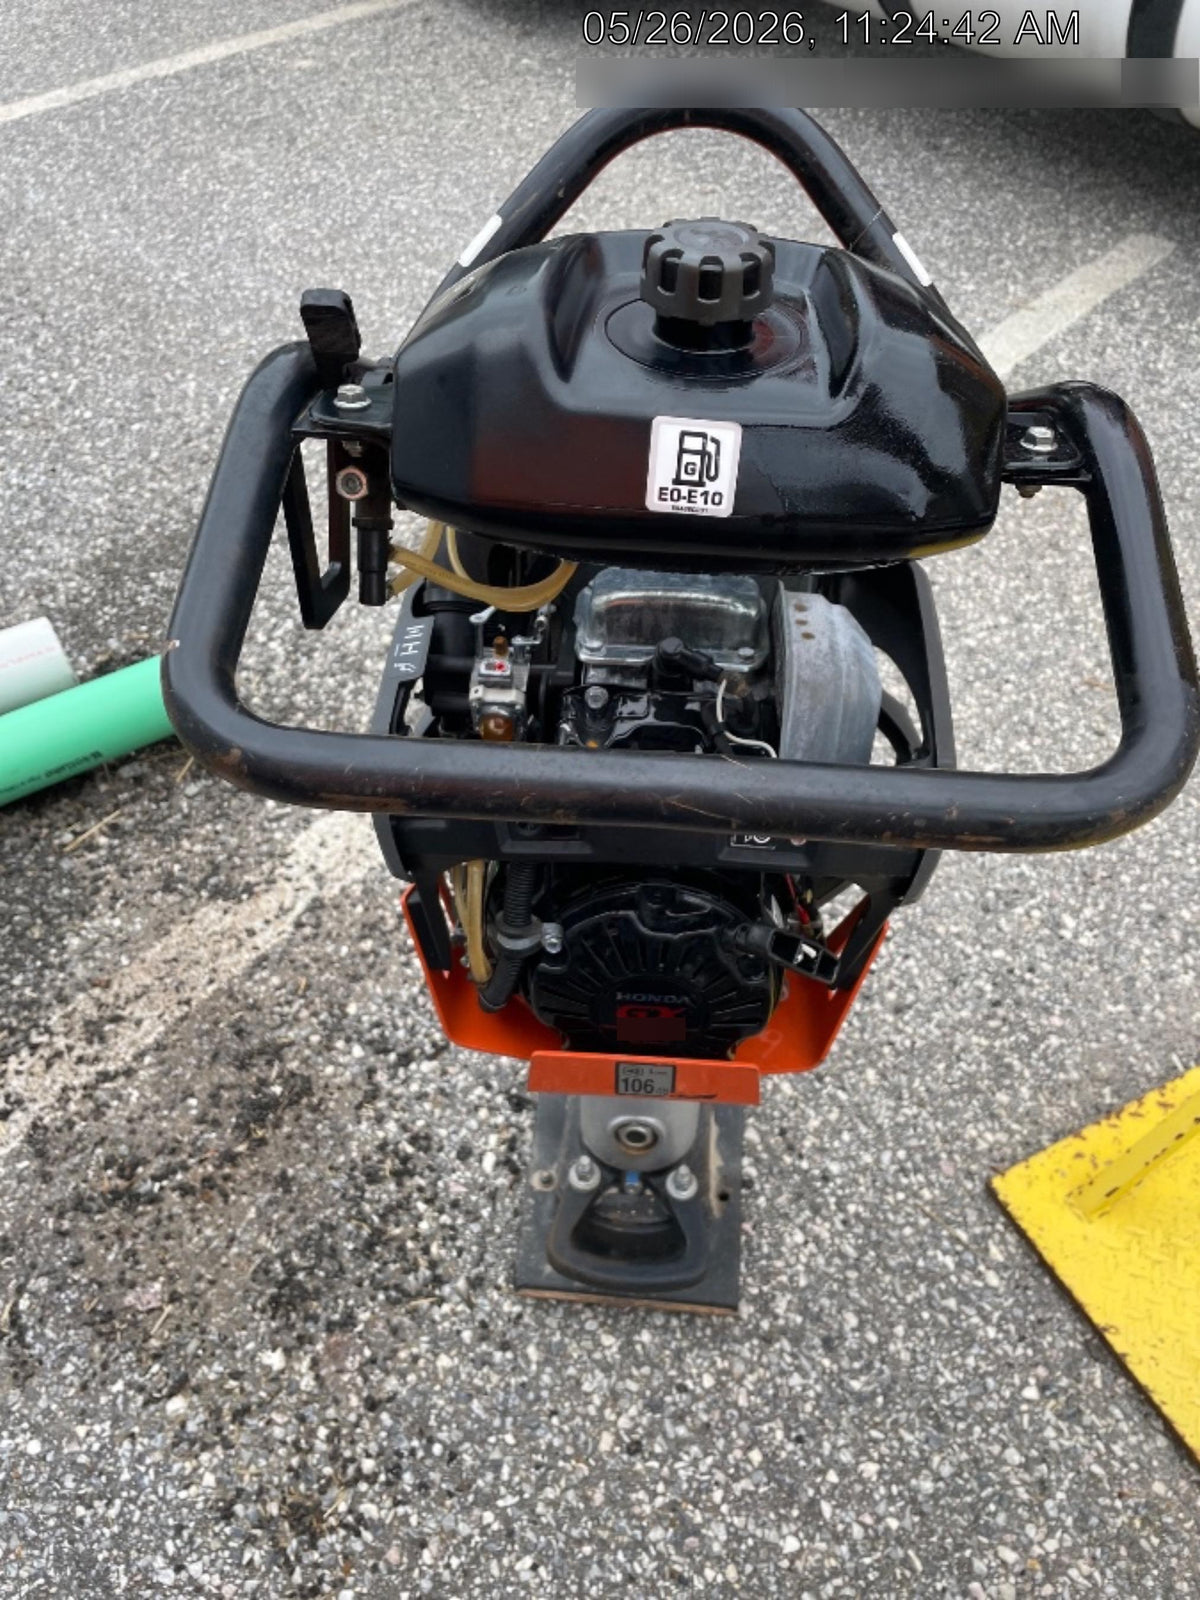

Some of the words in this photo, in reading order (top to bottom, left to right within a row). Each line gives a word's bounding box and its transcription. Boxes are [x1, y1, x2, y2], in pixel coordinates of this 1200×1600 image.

[684, 461, 697, 476] G
[616, 991, 691, 1004] HONDA
[621, 1077, 655, 1094] 106
